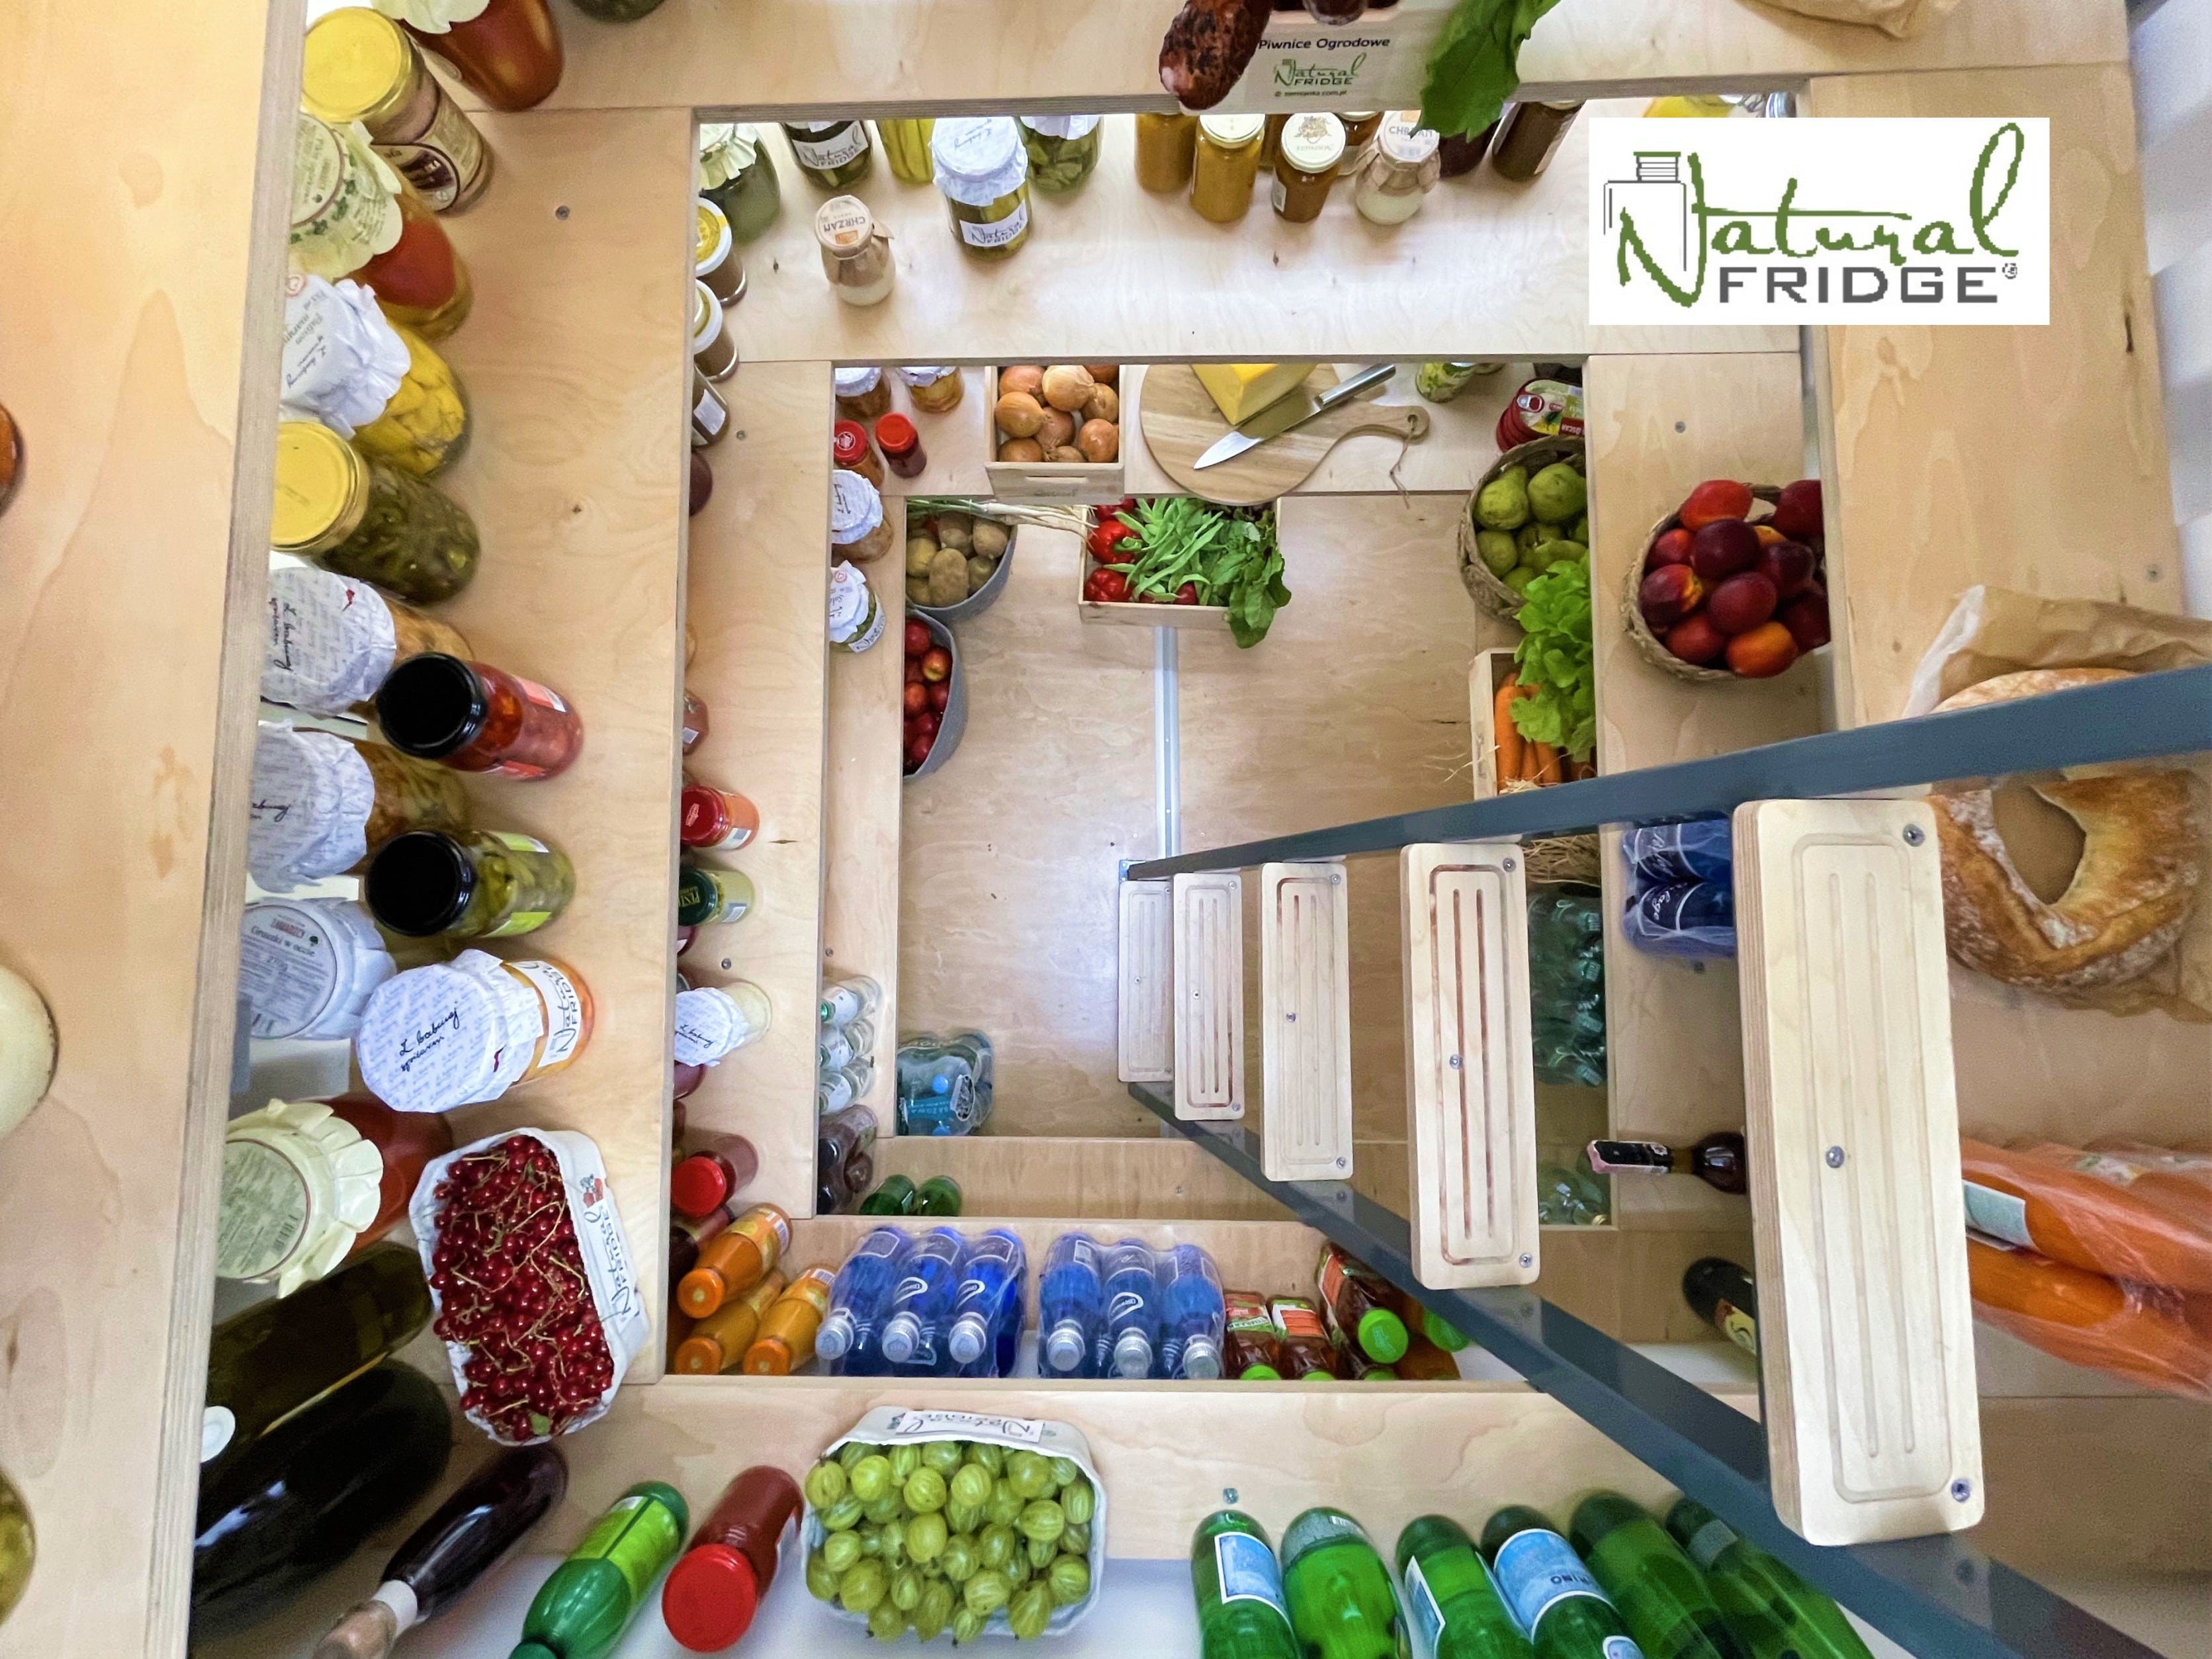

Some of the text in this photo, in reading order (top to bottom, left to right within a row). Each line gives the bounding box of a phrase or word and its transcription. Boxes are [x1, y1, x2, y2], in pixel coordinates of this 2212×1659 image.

[1258, 38, 1390, 51] Piwnice Ogrodowe
[1274, 52, 1367, 86] Natural
[1294, 77, 1354, 86] FRIDGE
[823, 216, 865, 232] CHRZAN
[517, 962, 577, 1054] Natural
[584, 1210, 632, 1316] Natural
